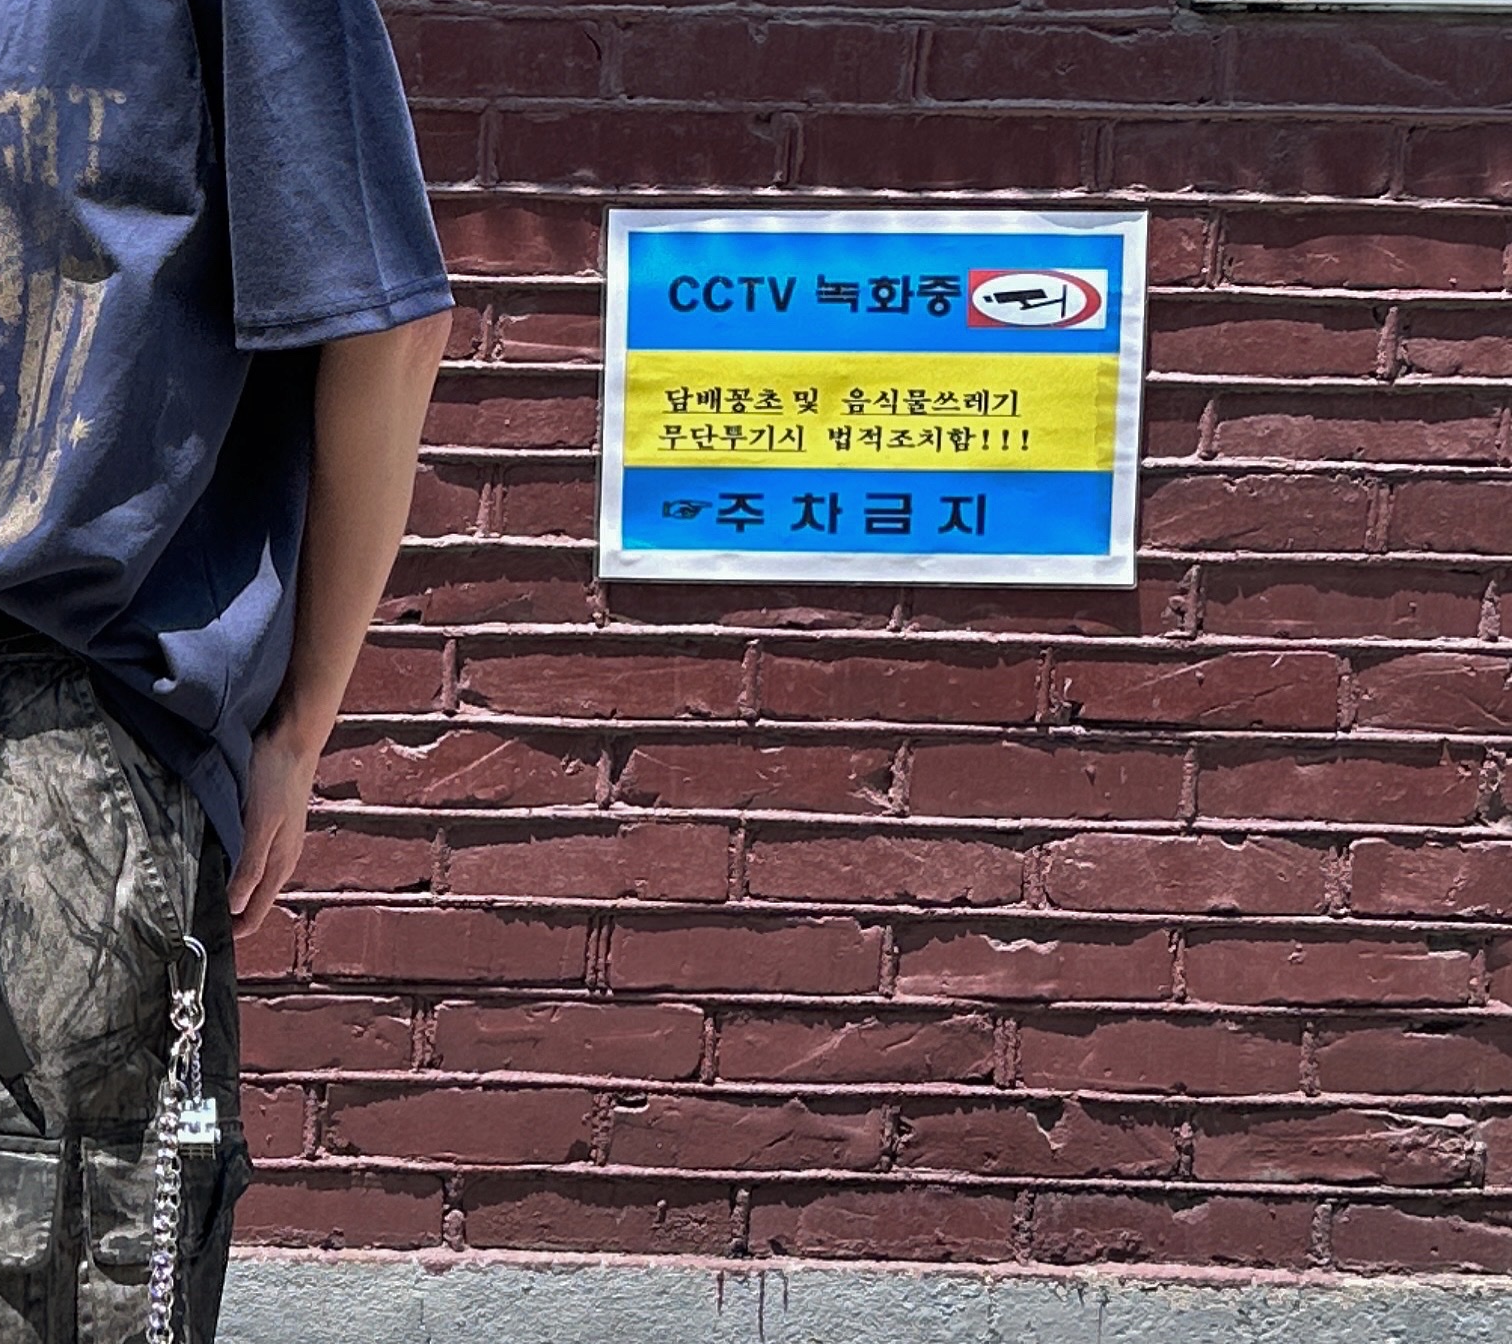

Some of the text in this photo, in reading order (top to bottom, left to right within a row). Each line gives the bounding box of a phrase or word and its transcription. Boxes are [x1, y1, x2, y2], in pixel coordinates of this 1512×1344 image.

[668, 273, 962, 318] CCTV 녹화중
[664, 387, 1020, 416] 담배꽁초 및 음식물쓰레기
[658, 424, 805, 452] 무단투기시
